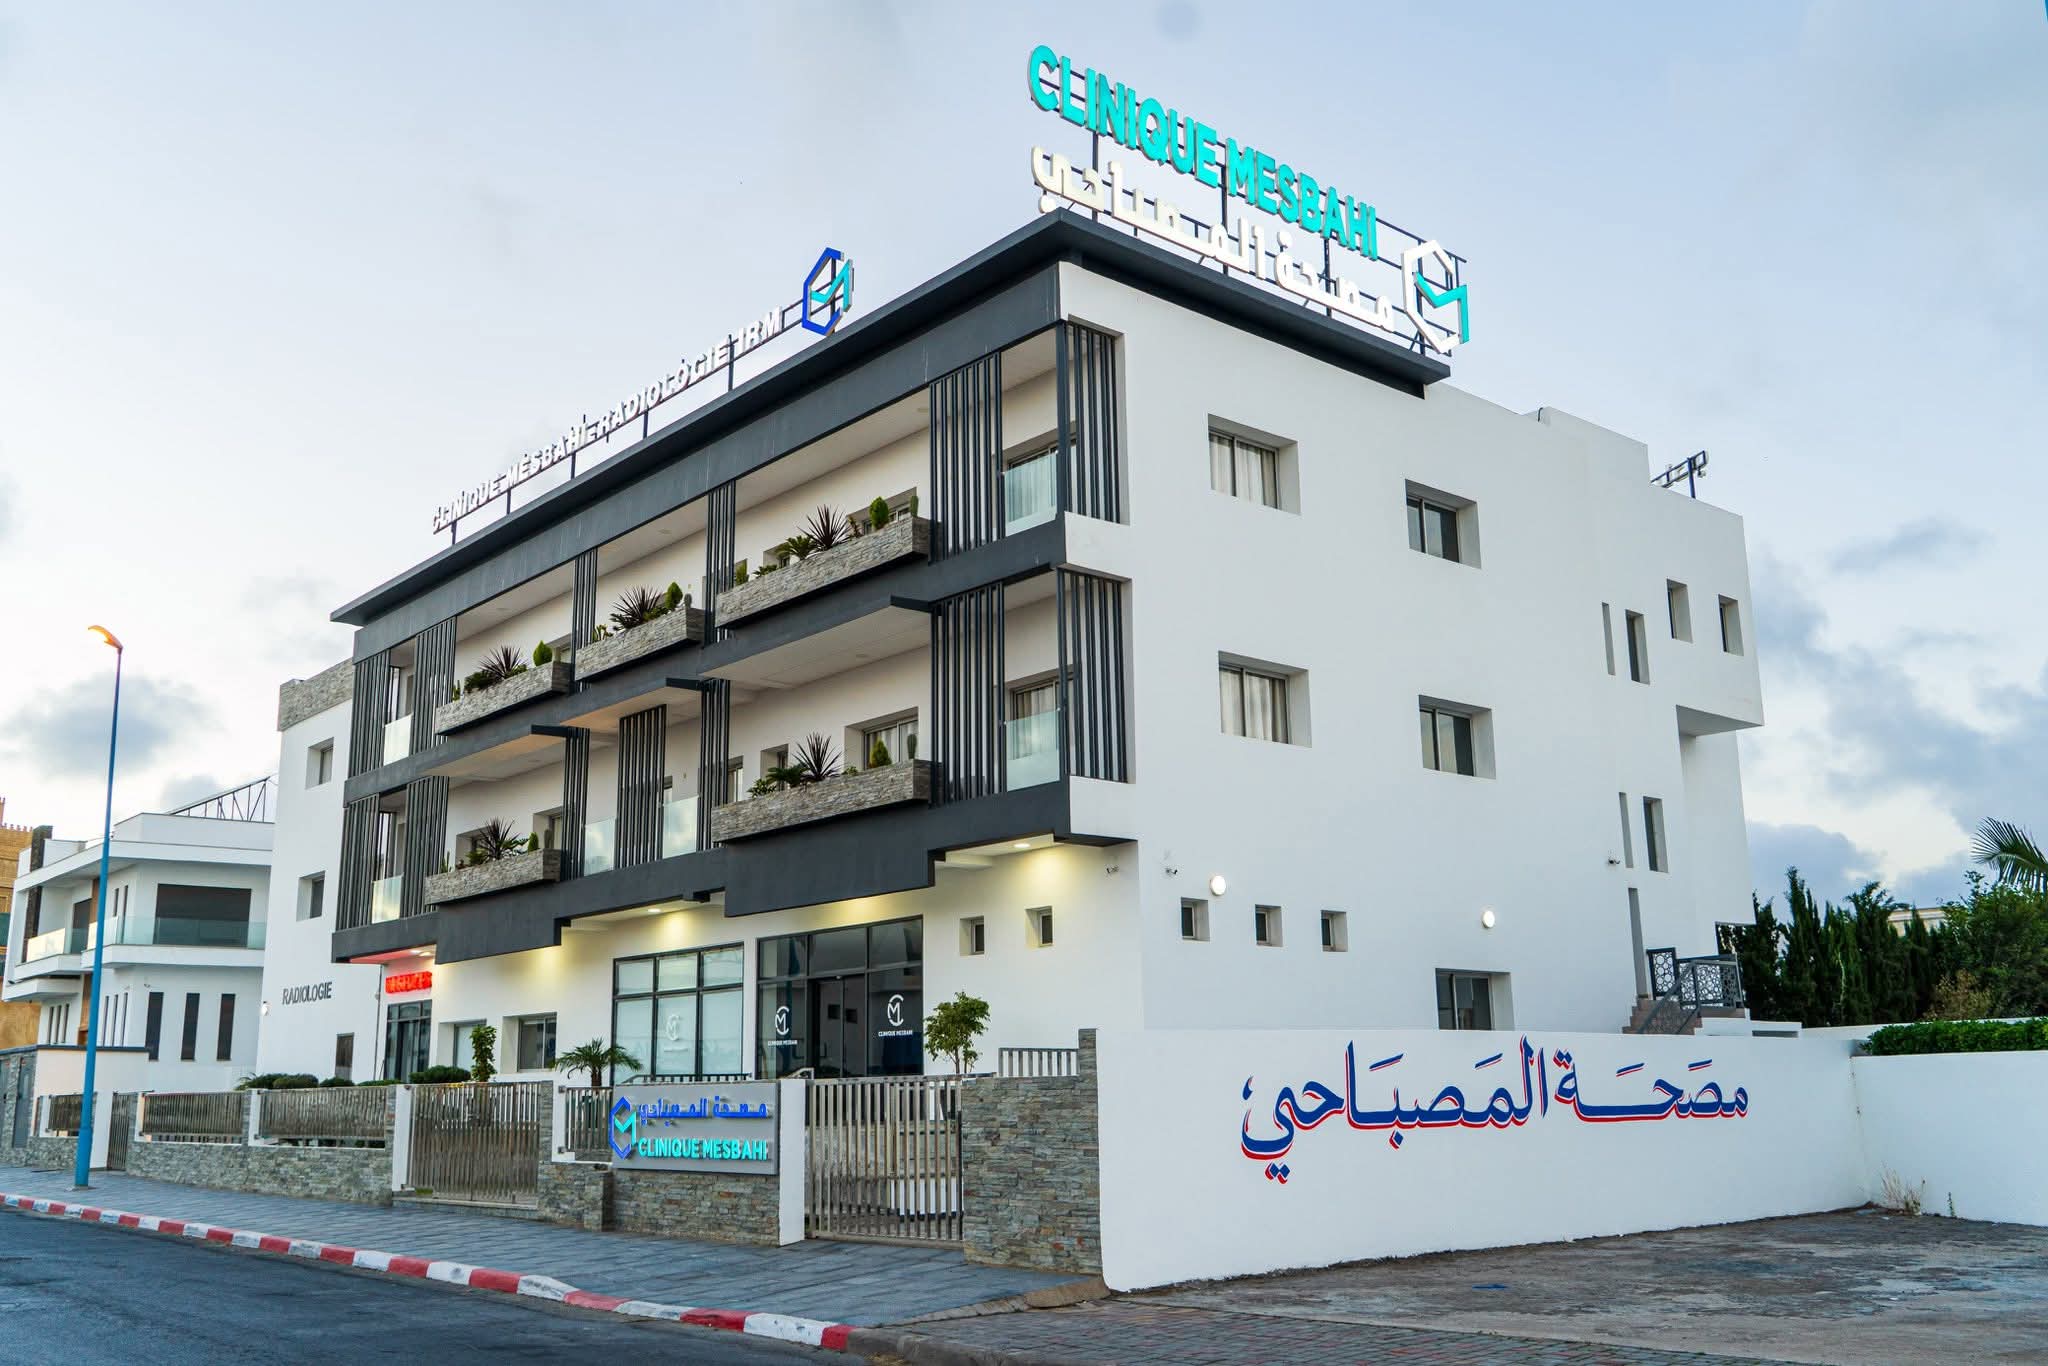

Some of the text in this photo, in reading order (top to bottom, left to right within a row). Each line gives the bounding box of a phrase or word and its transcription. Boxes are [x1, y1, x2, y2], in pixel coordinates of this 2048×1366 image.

[1028, 45, 1379, 261] CLINIQUE MESBAHI
[1273, 230, 1395, 334] مصحة
[735, 304, 783, 354] IRM
[282, 981, 333, 1005] RADIOLOGIE
[712, 1095, 769, 1119] مصحة
[638, 1136, 768, 1161] CLINIQUE MESBAHI
